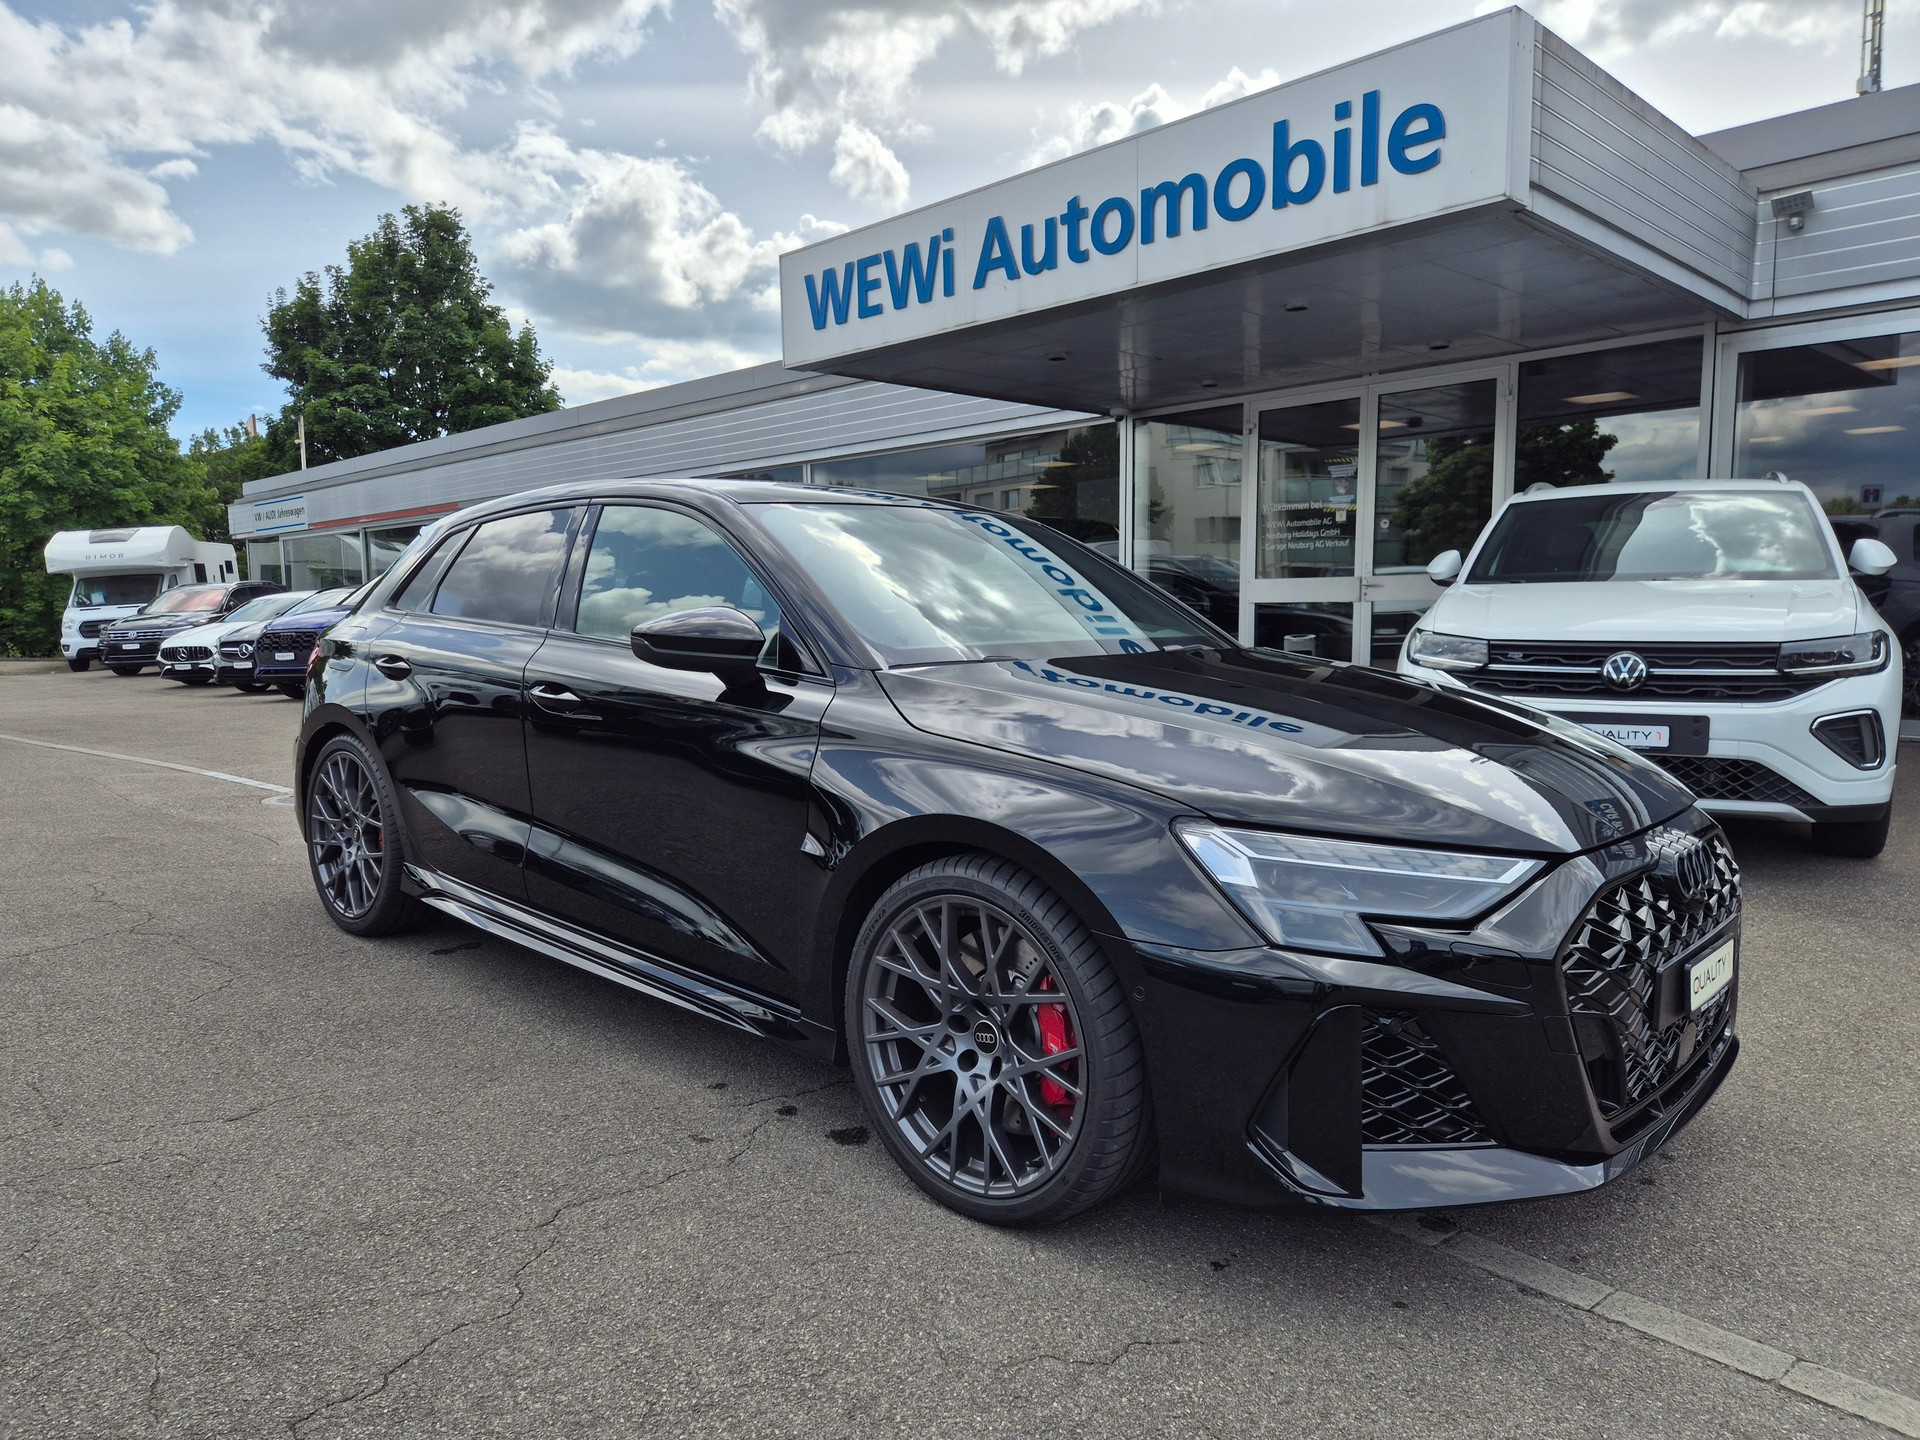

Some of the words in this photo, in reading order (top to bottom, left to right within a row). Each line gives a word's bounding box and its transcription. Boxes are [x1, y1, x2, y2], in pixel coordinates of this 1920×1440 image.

[804, 227, 955, 330] WEWi
[973, 89, 1446, 290] Automobile
[1263, 502, 1310, 512] Willkommen
[1311, 500, 1323, 509] bei
[1267, 521, 1285, 529] WEWi
[1286, 519, 1321, 527] Automobile
[1322, 517, 1332, 525] AG
[1266, 531, 1291, 540] Neuburg
[1293, 530, 1319, 539] Holidays
[1320, 528, 1340, 537] GmbH
[1266, 543, 1287, 551] Garage
[1288, 540, 1313, 550] Neuburg
[1315, 539, 1324, 548] AG
[1325, 539, 1349, 548] Verkauf
[1019, 909, 1065, 962] BRIDGESTONE
[1693, 953, 1727, 995] QUALITY
